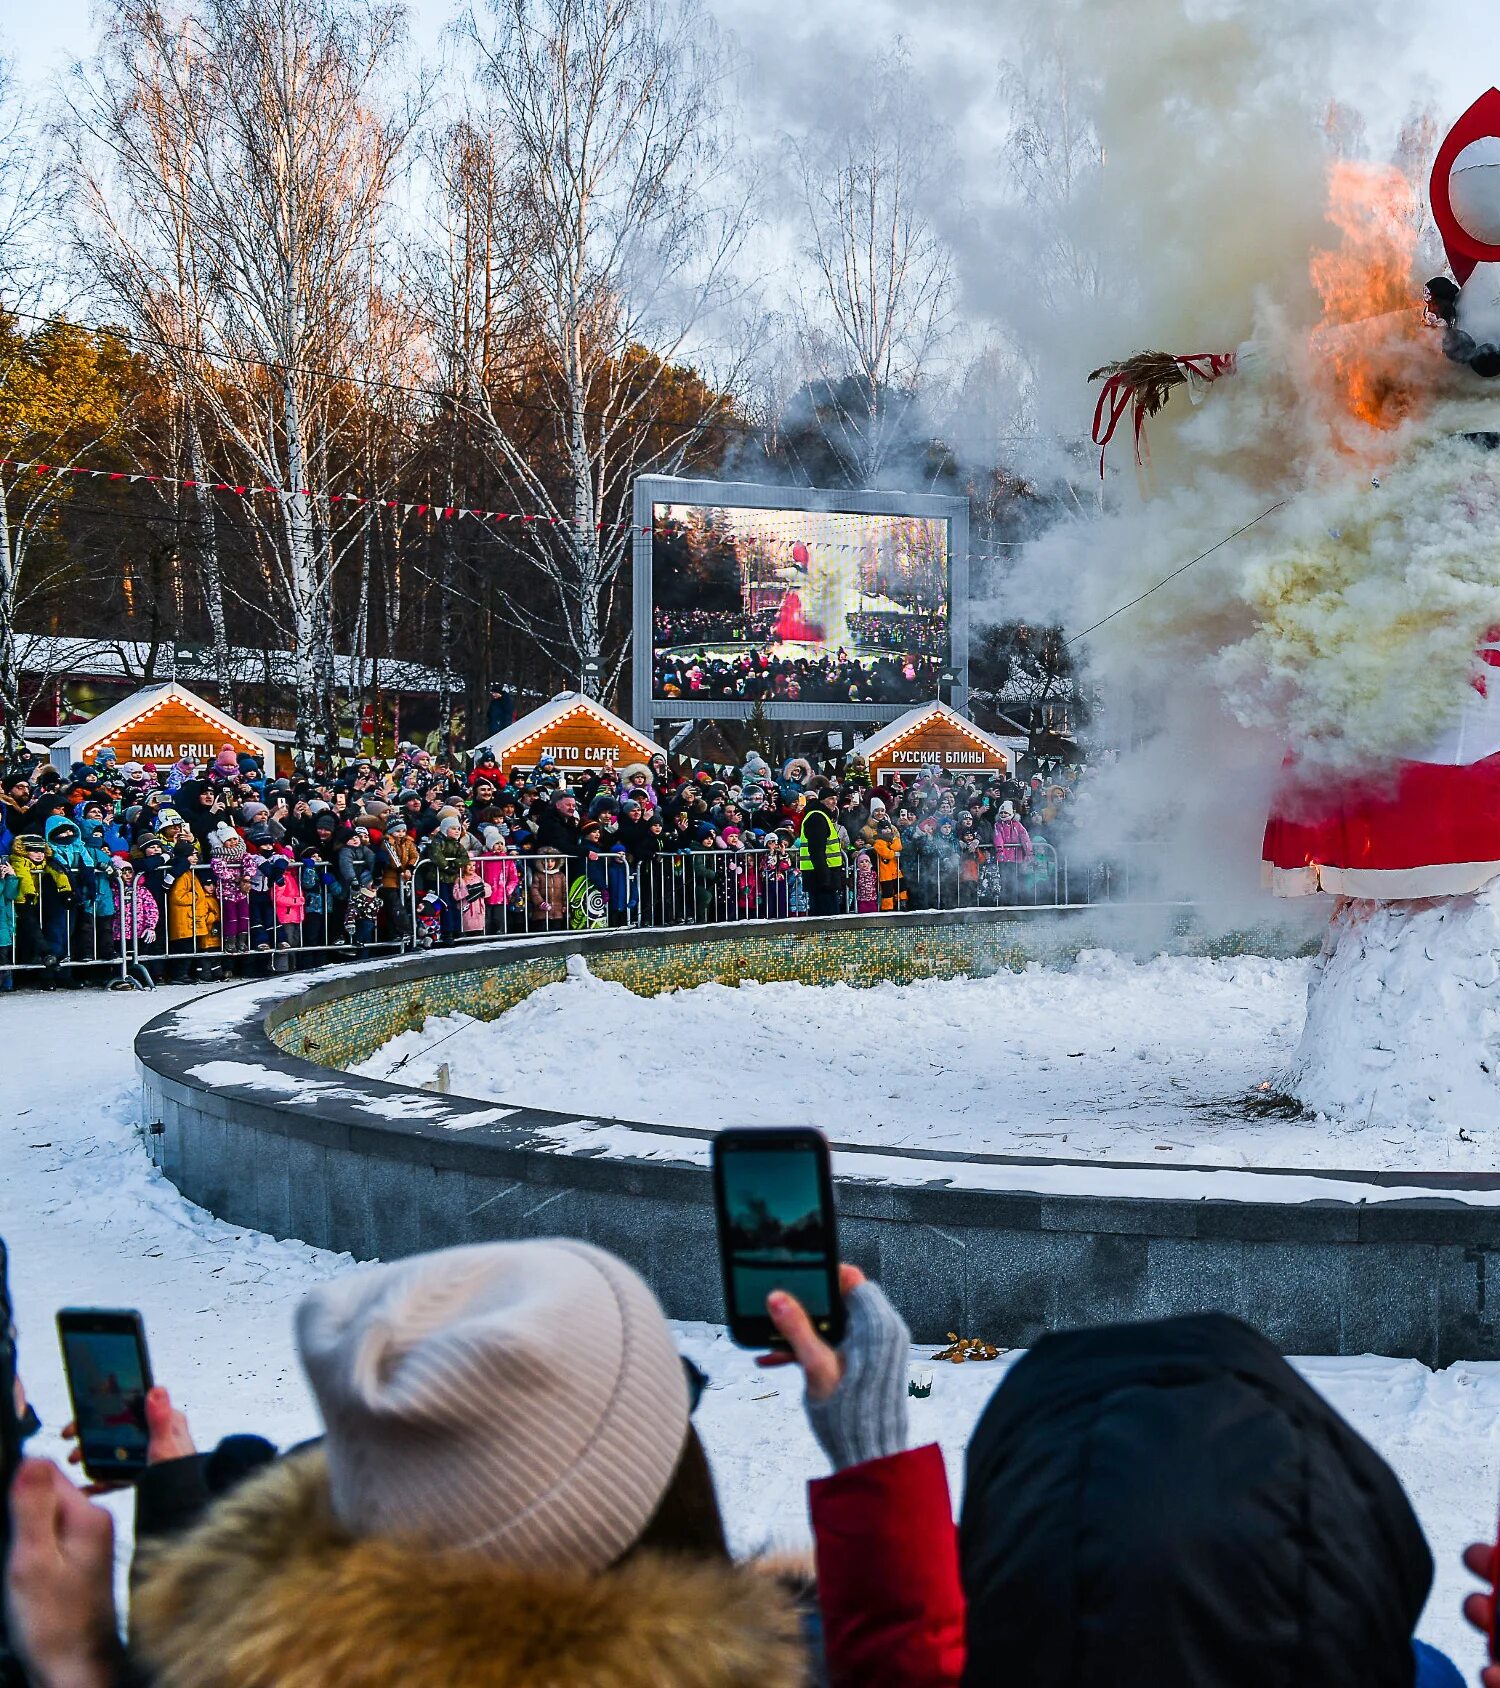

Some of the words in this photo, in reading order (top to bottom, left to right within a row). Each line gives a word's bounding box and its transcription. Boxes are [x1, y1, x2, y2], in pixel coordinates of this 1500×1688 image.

[131, 743, 175, 758] MAMA
[179, 743, 217, 758] GRILL
[541, 746, 579, 760] TUTTO
[892, 751, 942, 763] РУССКИЕ
[945, 751, 985, 764] БЛИНЫ
